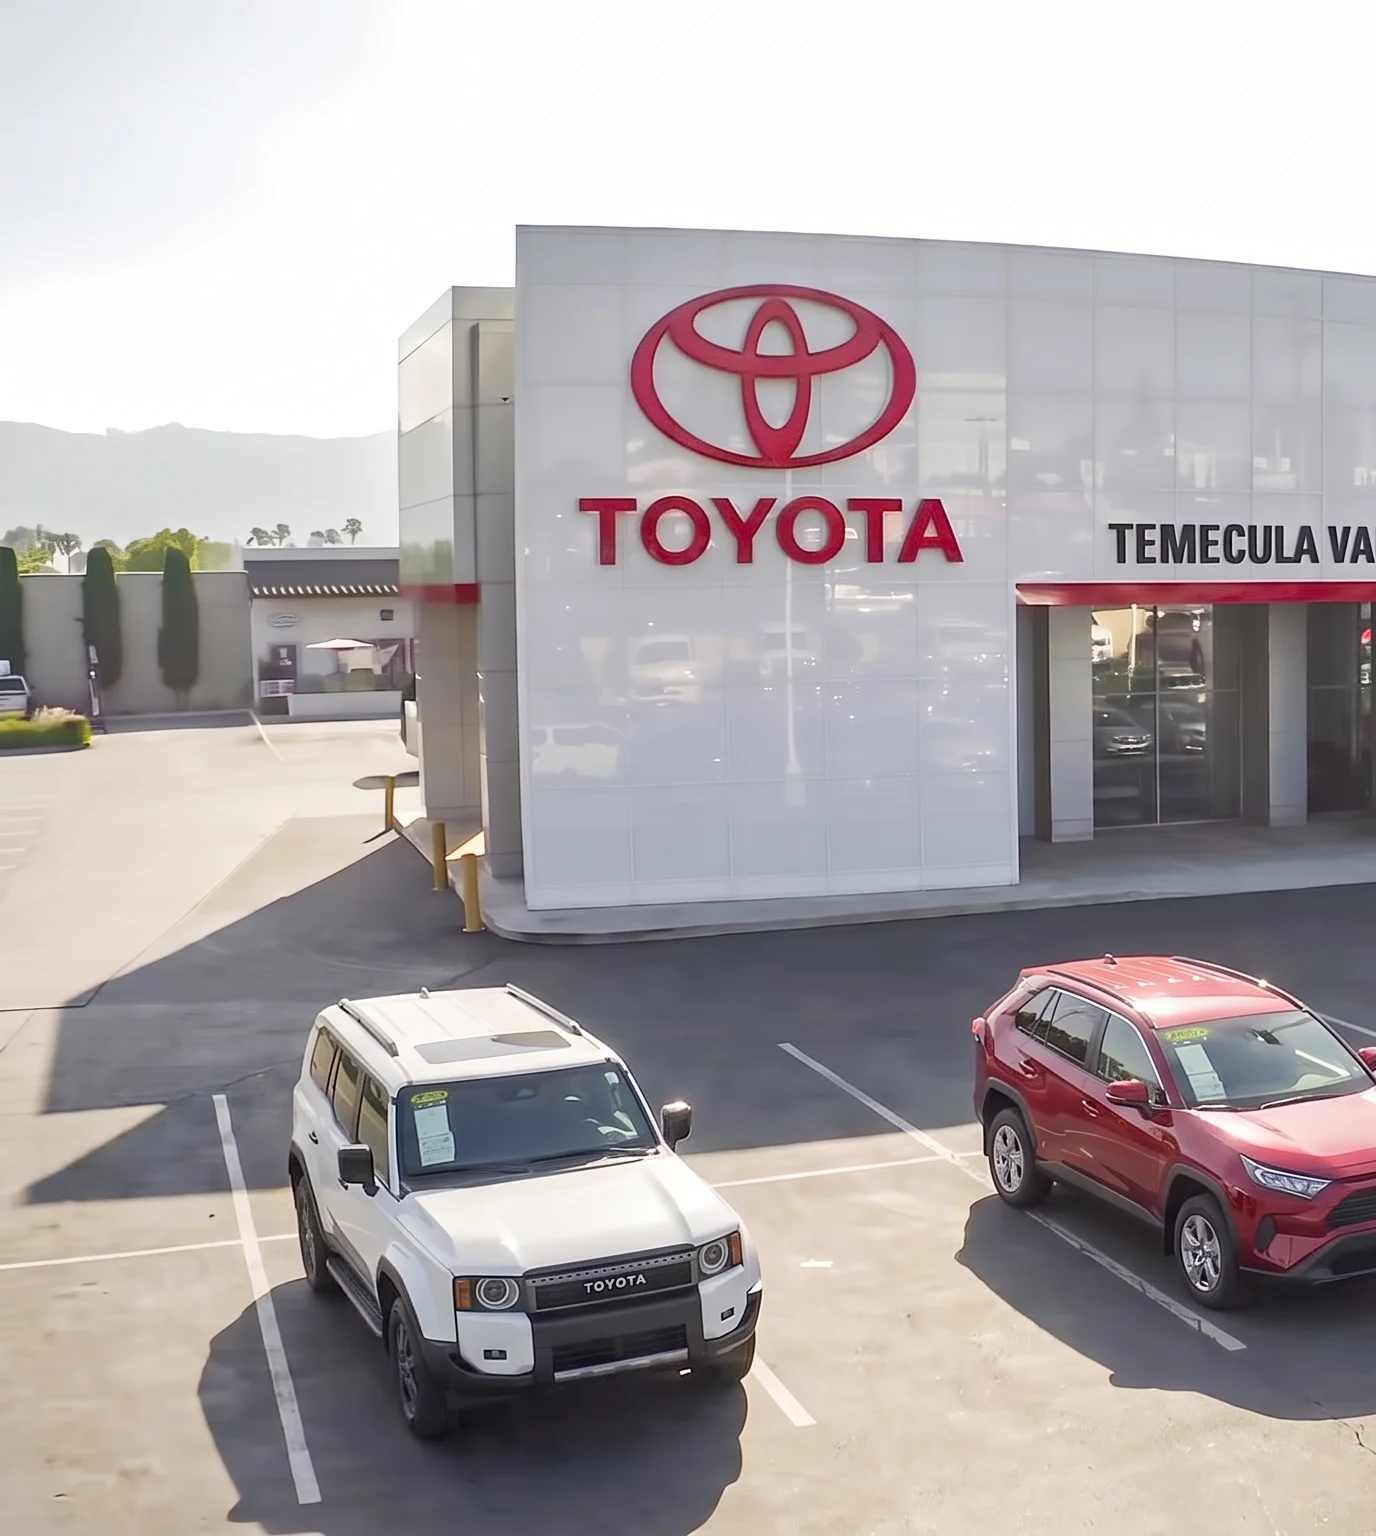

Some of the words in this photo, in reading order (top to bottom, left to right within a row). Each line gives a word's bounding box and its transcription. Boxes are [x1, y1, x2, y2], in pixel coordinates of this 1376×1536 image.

[579, 495, 963, 567] TOYOTA
[1107, 523, 1320, 565] TEMECULA
[583, 1273, 647, 1294] TOYOTA
